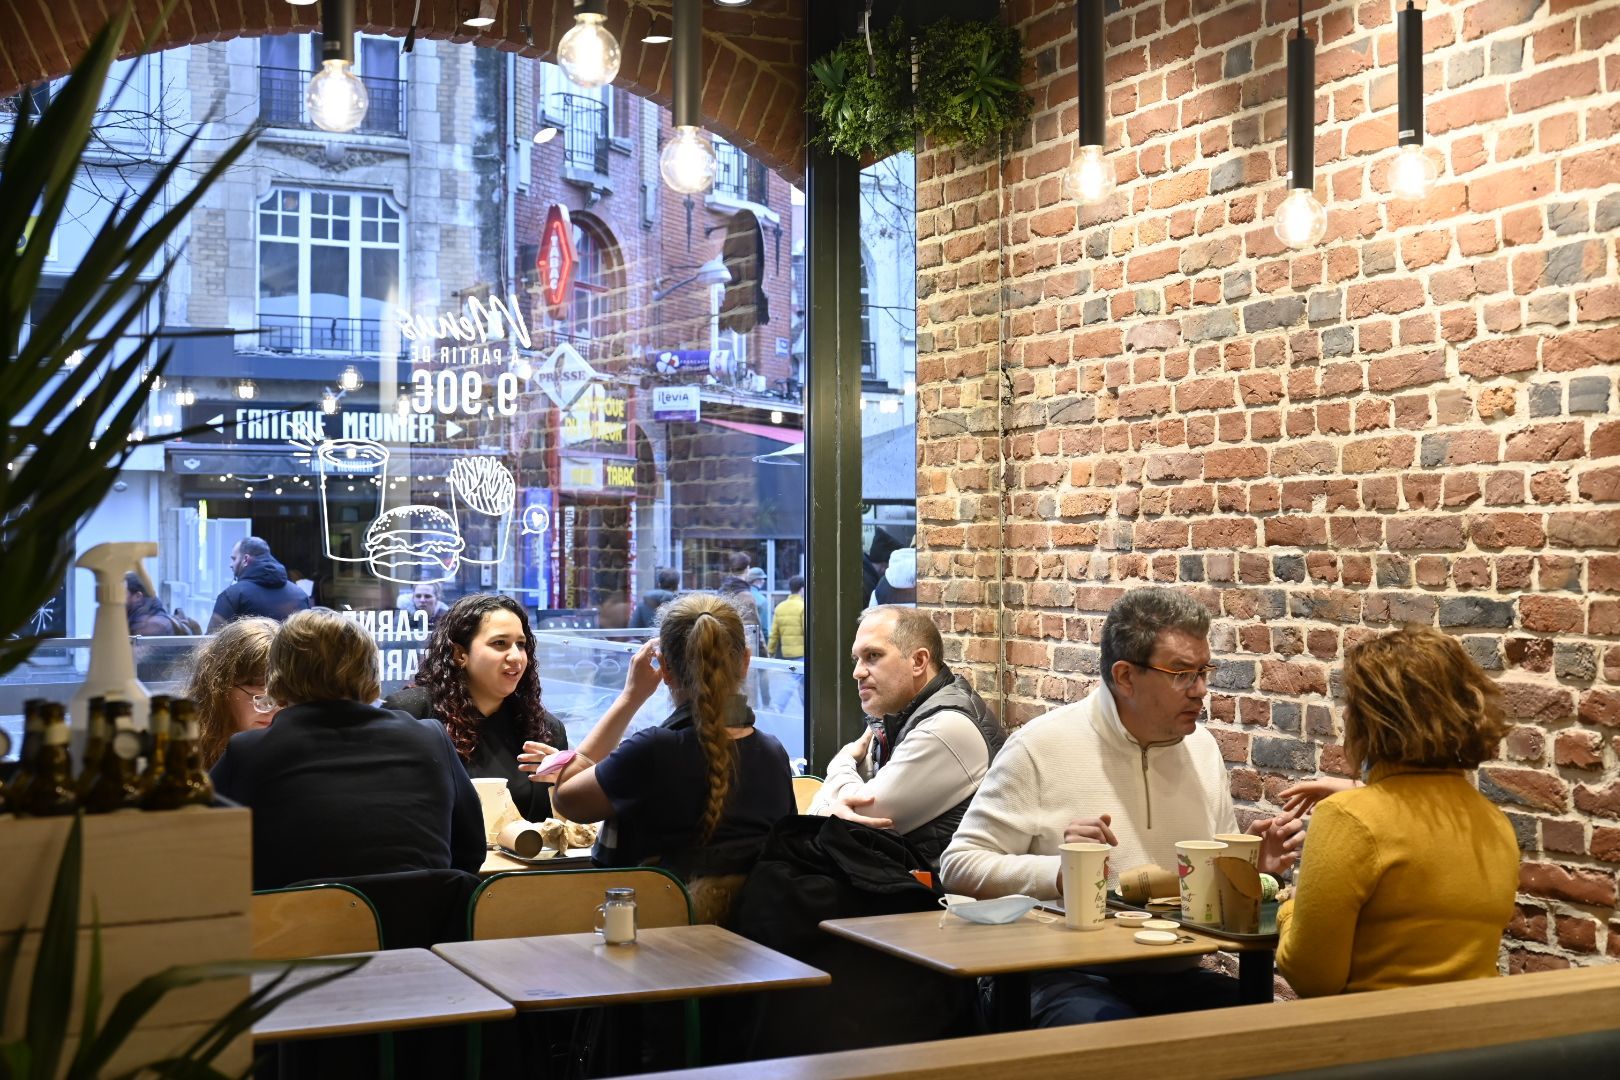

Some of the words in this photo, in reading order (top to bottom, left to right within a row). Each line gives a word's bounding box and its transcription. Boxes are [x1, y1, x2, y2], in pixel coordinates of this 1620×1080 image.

[550, 235, 560, 290] TABAC
[236, 408, 326, 440] FRITERIE
[342, 411, 435, 443] MEUNIER
[607, 467, 635, 486] TABAC
